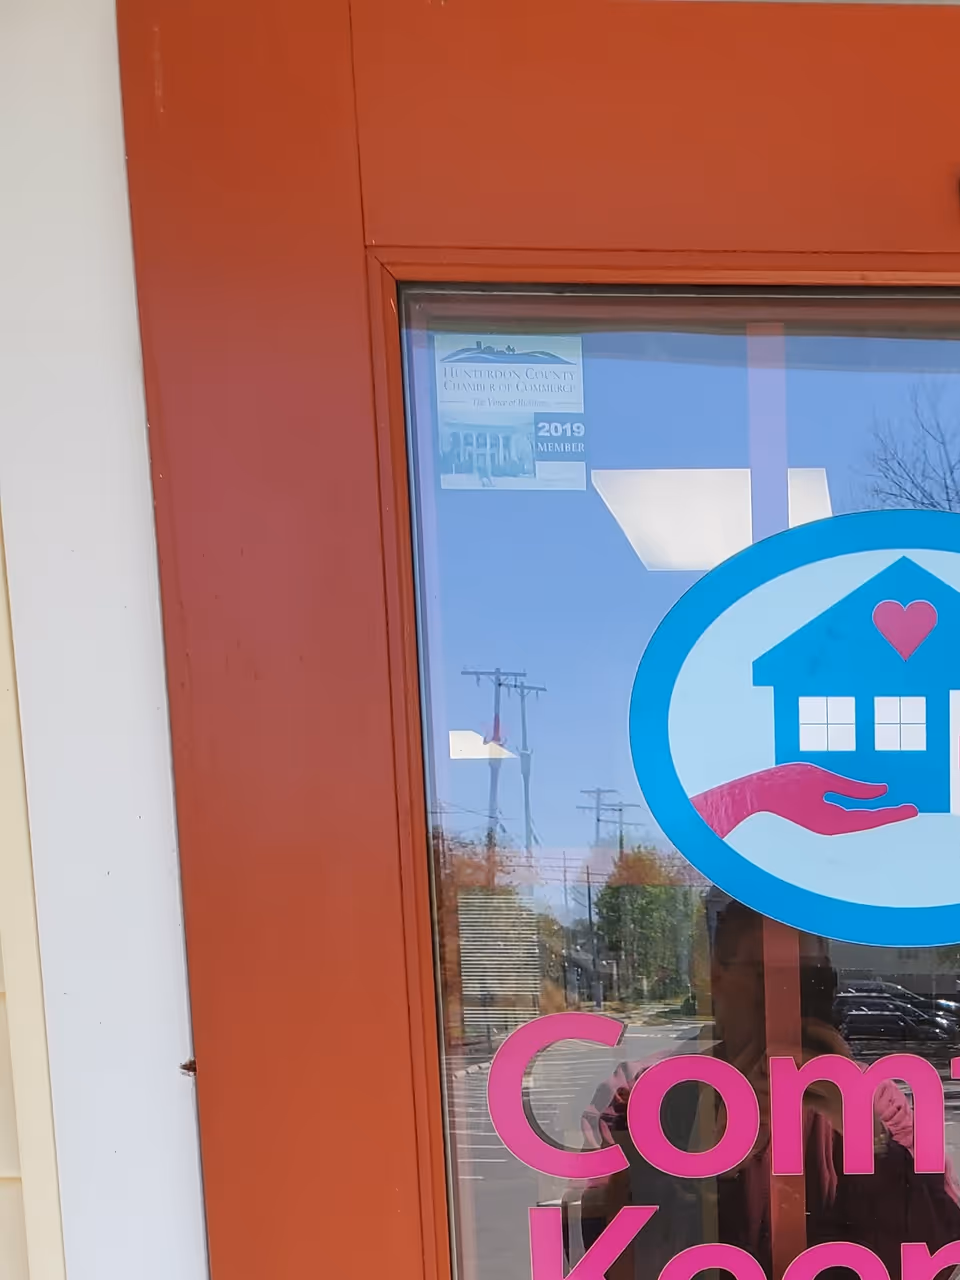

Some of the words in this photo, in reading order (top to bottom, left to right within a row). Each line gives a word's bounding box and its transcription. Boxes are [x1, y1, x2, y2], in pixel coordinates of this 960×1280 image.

[525, 367, 576, 381] COUNTY
[537, 422, 585, 437] 2019
[537, 442, 585, 453] MEMBER
